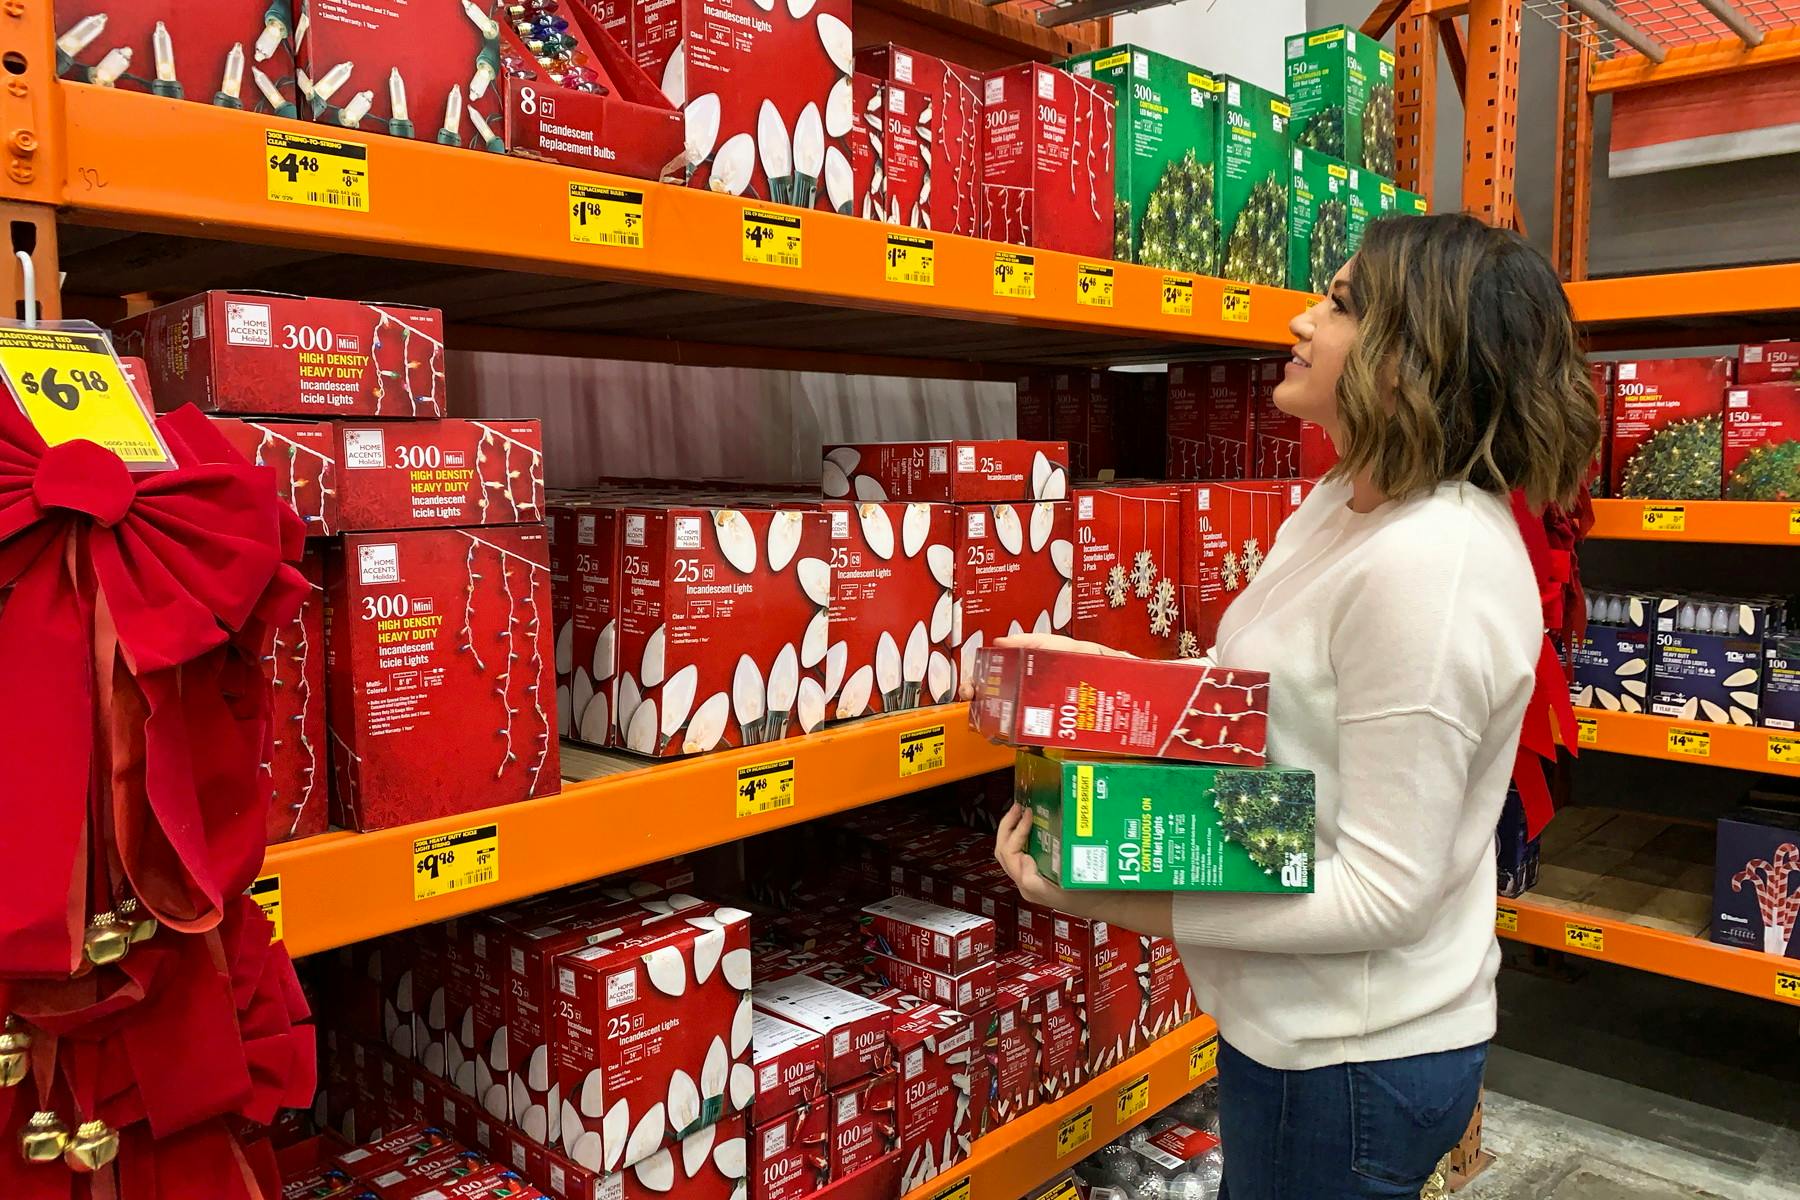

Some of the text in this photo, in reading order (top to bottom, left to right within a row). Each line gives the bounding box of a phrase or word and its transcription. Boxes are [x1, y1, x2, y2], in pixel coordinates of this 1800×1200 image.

[704, 4, 772, 33] Incandescent Lights
[1288, 62, 1306, 77] 150
[520, 86, 553, 114] 8 C7
[1134, 84, 1152, 102] 300
[985, 109, 1007, 129] 300
[1038, 105, 1057, 124] 300
[1227, 111, 1243, 127] 300
[540, 120, 593, 141] Incandescent
[889, 118, 900, 134] 50
[268, 138, 287, 147] CLEAR
[540, 136, 616, 160] Replacement Bulbs
[578, 185, 609, 194] REPLACEMENT
[243, 320, 267, 328] HOME
[0, 332, 72, 344] RADITIONAL RED
[242, 335, 267, 344] Holiday
[282, 325, 357, 352] 300 Mini
[31, 341, 55, 349] BOW
[56, 343, 90, 352] W/BELL
[299, 353, 369, 366] HIGH DENSITY
[1767, 352, 1787, 362] 150
[300, 366, 364, 379] HEAVY DUTY
[300, 379, 359, 392] Incandescent
[1618, 383, 1643, 397] 300
[301, 393, 353, 406] Icicle Lights
[1728, 412, 1749, 422] 150
[395, 446, 462, 469] 300 Mini
[913, 448, 924, 468] 25
[980, 457, 994, 473] 25
[410, 470, 474, 480] HIGH DENSITY
[411, 482, 469, 493] HEAVY DUTY
[412, 495, 465, 505] Incandescent
[412, 507, 461, 519] Icicle Lights
[1199, 516, 1208, 532] 10
[1078, 526, 1092, 544] 10
[576, 554, 590, 572] 25
[830, 548, 860, 568] 25 C9
[968, 546, 985, 565] 25
[625, 555, 639, 574] 25
[674, 559, 713, 582] 25 C9
[976, 563, 1020, 575] Incandescent Lights
[837, 569, 892, 579] Incandescent Lights
[687, 584, 752, 595] Incandescent Lights
[362, 594, 431, 620] 300 Mini
[378, 616, 442, 631] HIGH DENSITY
[378, 628, 437, 643] HEAVY DUTY
[1656, 634, 1672, 645] 50
[379, 641, 434, 656] Incandescent
[380, 655, 429, 668] Icicle Lights
[1768, 659, 1787, 669] 100
[1058, 705, 1079, 740] 300
[1097, 780, 1106, 799] LED
[430, 836, 447, 844] HEAVY
[1142, 798, 1152, 873] CONTINUOUS ON
[432, 841, 450, 849] STRING
[1118, 820, 1140, 885] 150 Mini
[1154, 816, 1164, 873] LED Net Lights
[921, 929, 930, 946] 50
[1018, 931, 1033, 945] 150
[974, 943, 983, 954] 50
[1054, 941, 1070, 956] 150
[1151, 945, 1164, 962] 150
[1095, 949, 1110, 967] 150
[512, 979, 523, 997] 25
[609, 988, 634, 1000] ACCENTS
[618, 983, 633, 991] HOME
[560, 1001, 574, 1019] 25
[608, 1014, 642, 1040] 25 C7
[1048, 1016, 1058, 1031] 50
[620, 1018, 679, 1046] Incandescent Lights
[854, 1031, 874, 1050] 100
[1001, 1038, 1012, 1052] 50
[783, 1062, 804, 1083] 100
[905, 1080, 925, 1104] 150
[375, 1138, 405, 1152] 100
[837, 1125, 860, 1151] 100
[842, 1136, 872, 1155] Incandescent
[842, 1153, 856, 1165] Lights
[410, 1161, 442, 1176] 100
[763, 1158, 788, 1186] 100
[451, 1180, 483, 1196] 100
[768, 1169, 802, 1191] Incandescent
[768, 1186, 784, 1200] Lights
